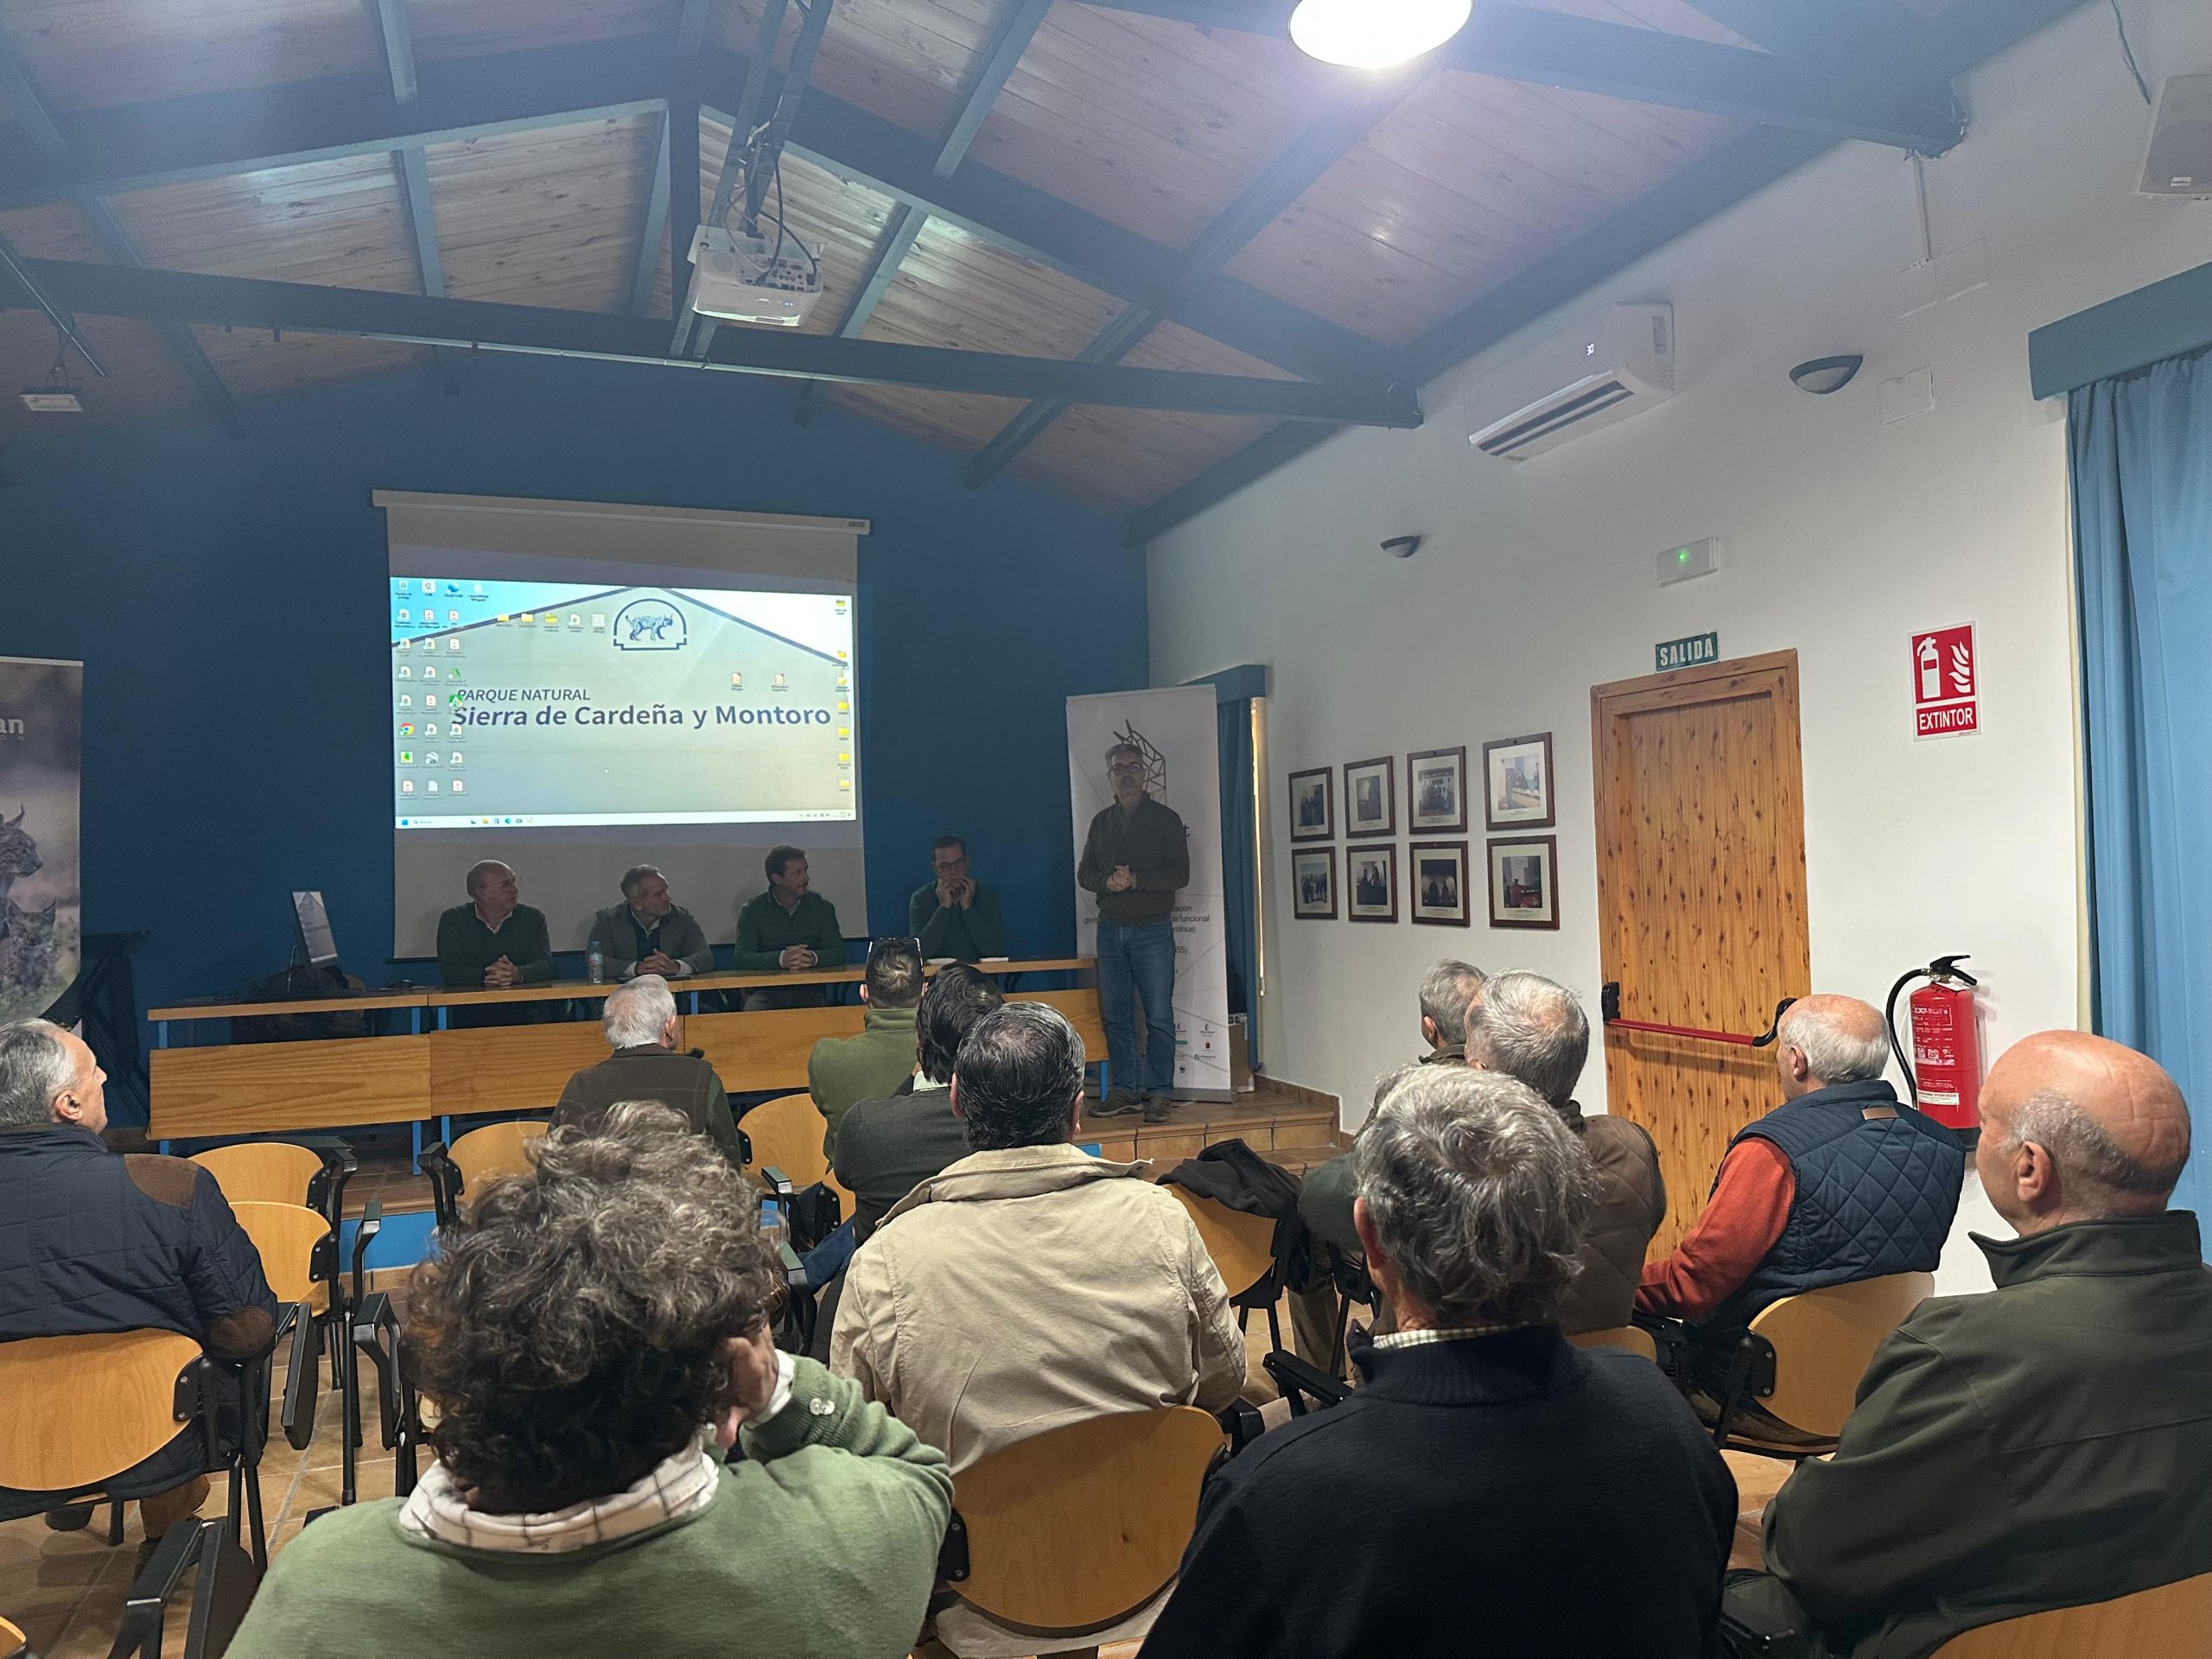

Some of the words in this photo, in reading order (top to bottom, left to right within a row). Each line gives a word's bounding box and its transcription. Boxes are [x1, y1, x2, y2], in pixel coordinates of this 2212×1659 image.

[1660, 638, 1713, 666] SALIDA
[457, 689, 518, 702] PARQUE
[521, 689, 591, 701] NATURAL
[452, 706, 527, 726] Sierra
[536, 705, 567, 726] de
[575, 703, 683, 725] Cardeña
[692, 709, 708, 729] y
[715, 705, 831, 725] Montoro
[1919, 707, 1974, 730] EXTINTOR
